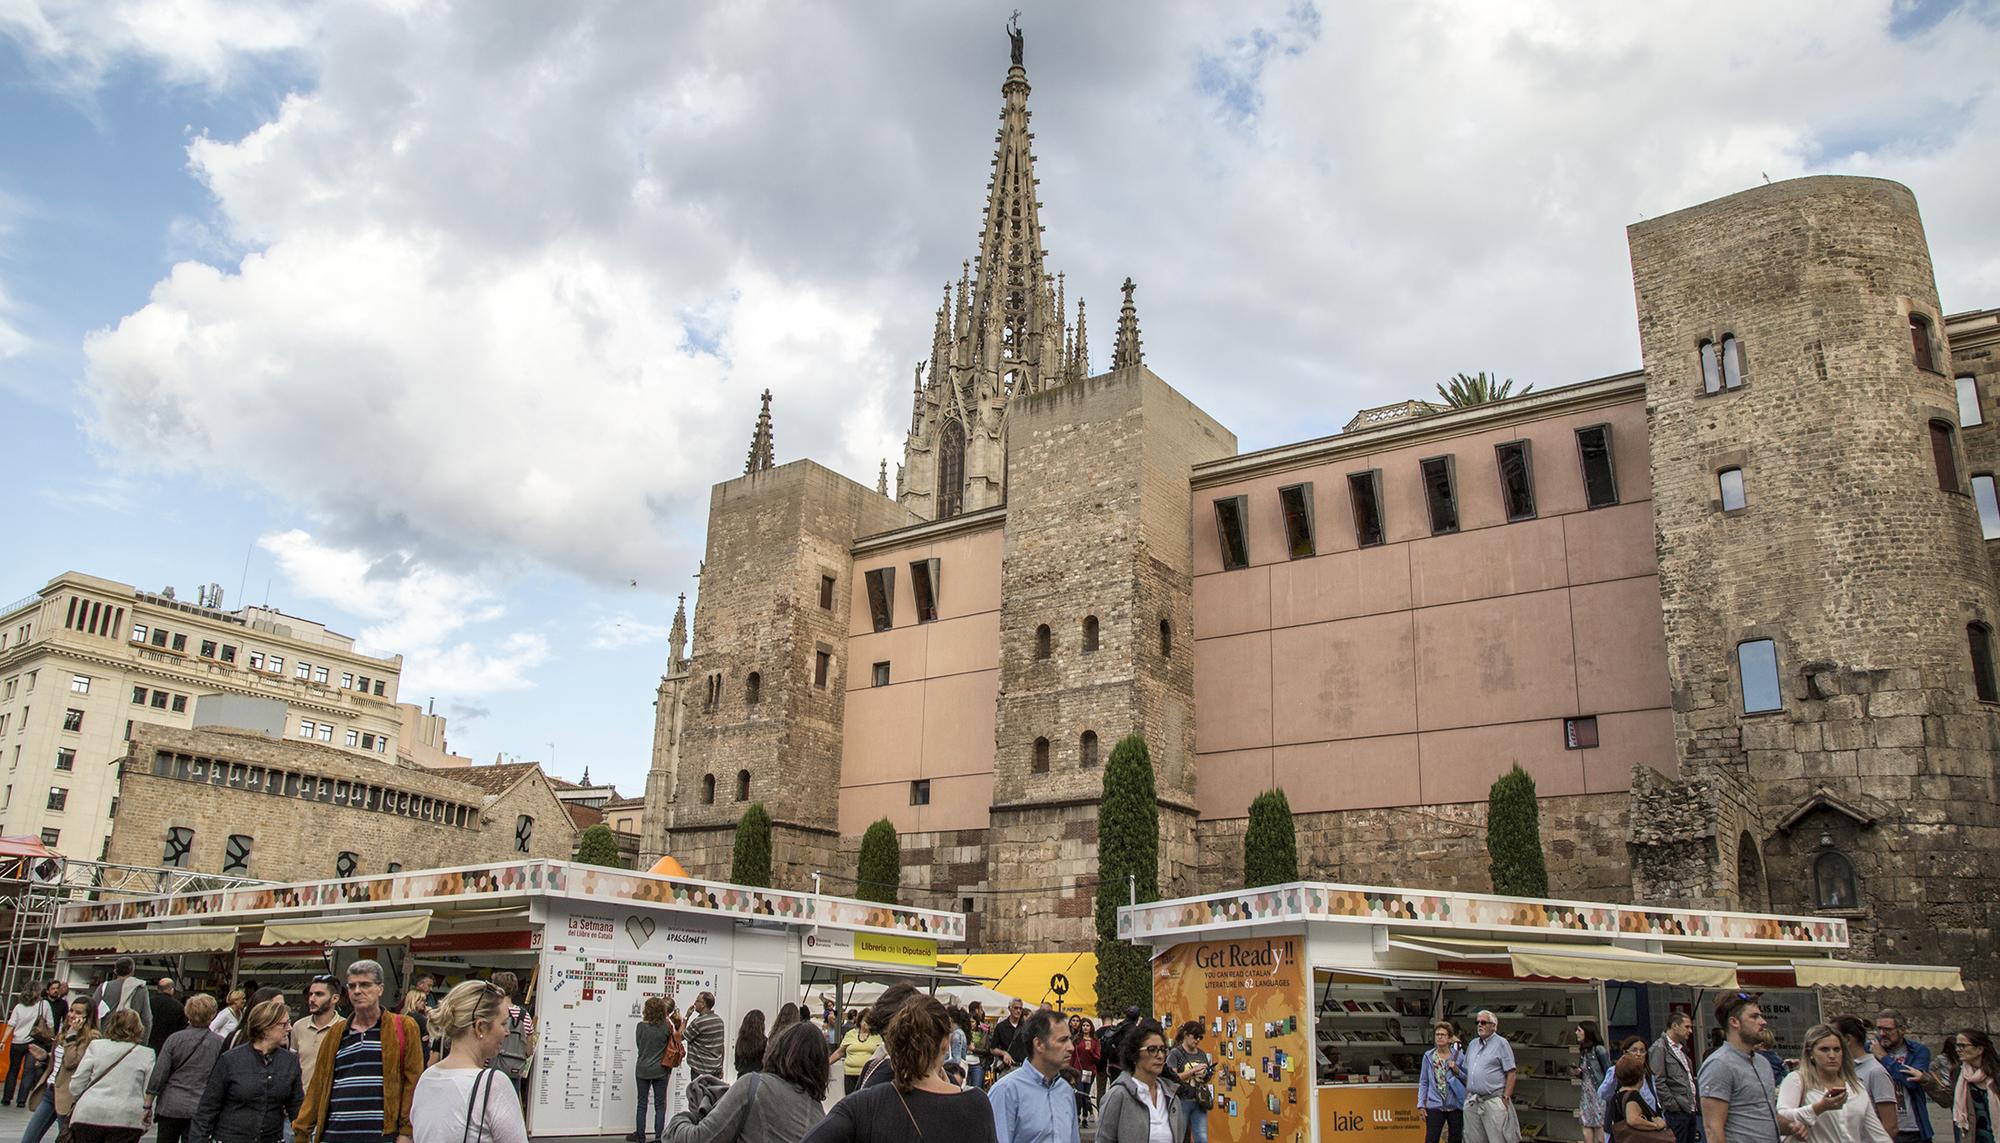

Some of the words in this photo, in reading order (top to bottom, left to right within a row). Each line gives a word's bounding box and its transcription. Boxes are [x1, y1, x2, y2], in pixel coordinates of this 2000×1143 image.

[568, 917, 578, 929] La
[580, 918, 614, 933] Setmana
[532, 933, 542, 945] 37
[576, 930, 590, 938] Llibre
[861, 941, 887, 953] Llibreria
[902, 946, 932, 956] Diputació
[1196, 946, 1225, 969] Get
[1229, 940, 1294, 975] Ready!!
[1205, 971, 1216, 979] YOU
[1217, 971, 1228, 979] CAN
[1229, 970, 1244, 978] READ
[1205, 981, 1238, 989] LITERATURE
[1244, 978, 1254, 989] 62
[1255, 979, 1290, 987] LANGUAGES
[1773, 1004, 1790, 1013] BCN
[1333, 1110, 1364, 1132] laie
